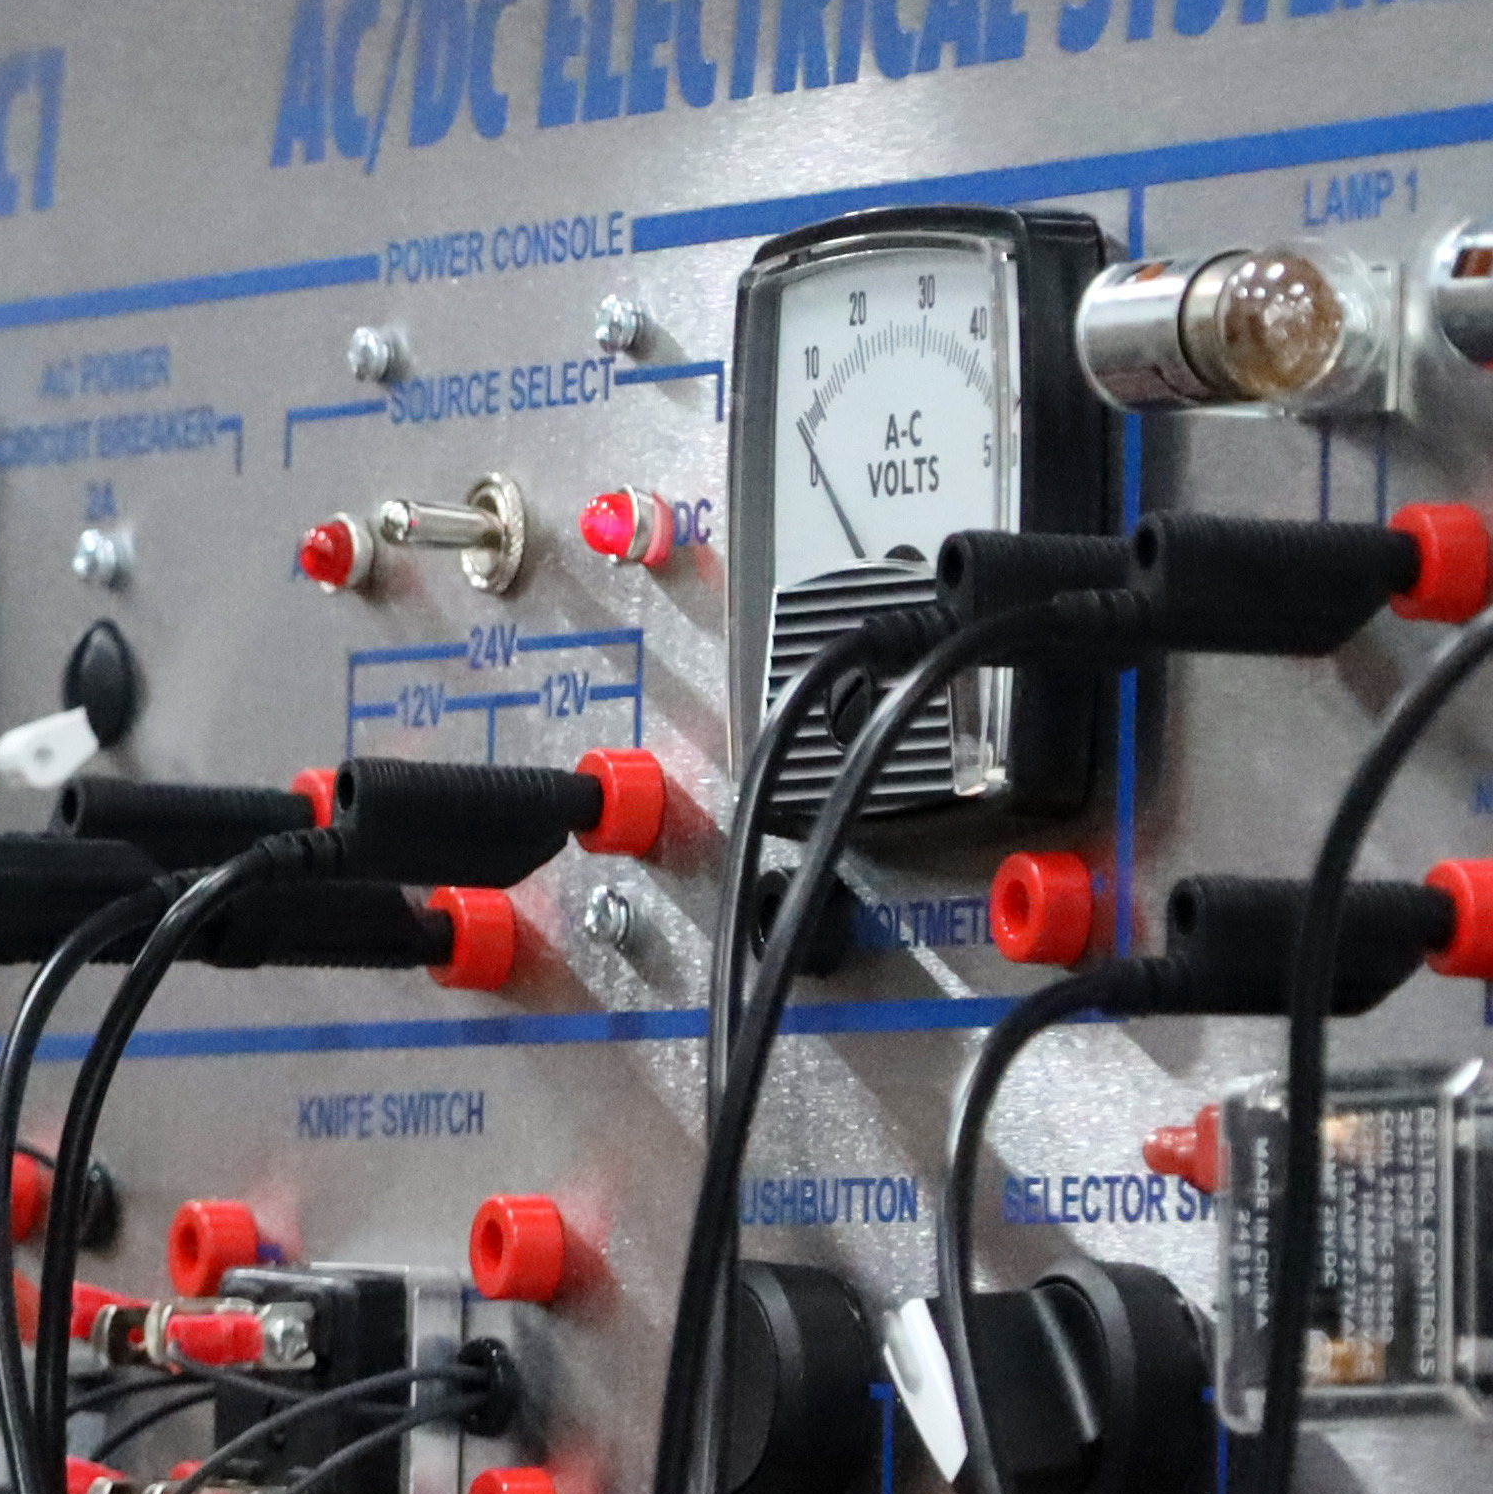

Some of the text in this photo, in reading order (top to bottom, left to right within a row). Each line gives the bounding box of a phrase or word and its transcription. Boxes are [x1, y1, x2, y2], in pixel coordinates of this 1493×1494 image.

[1303, 167, 1418, 227] LAMP 1
[386, 212, 624, 284] POWER CONSOLE
[849, 291, 867, 327] 20
[919, 275, 935, 309] 30
[970, 307, 987, 340] 40
[805, 346, 819, 380] 10
[390, 357, 615, 424] SOURCE SELECT
[885, 410, 923, 450] A-C
[868, 456, 939, 498] VOLTS
[674, 498, 712, 544] DC
[469, 624, 517, 670] 24V
[397, 684, 444, 727] 12V
[540, 672, 589, 717] 12V
[855, 897, 994, 948] VOLTMET
[298, 1089, 485, 1139] KNIFE SWITCH
[740, 1176, 918, 1226] USHBUTTON
[1002, 1174, 1164, 1224] SELECTOR
[1255, 1136, 1269, 1330] MADE IN CHINA
[1419, 1106, 1436, 1376] DELTROL CONTROLS
